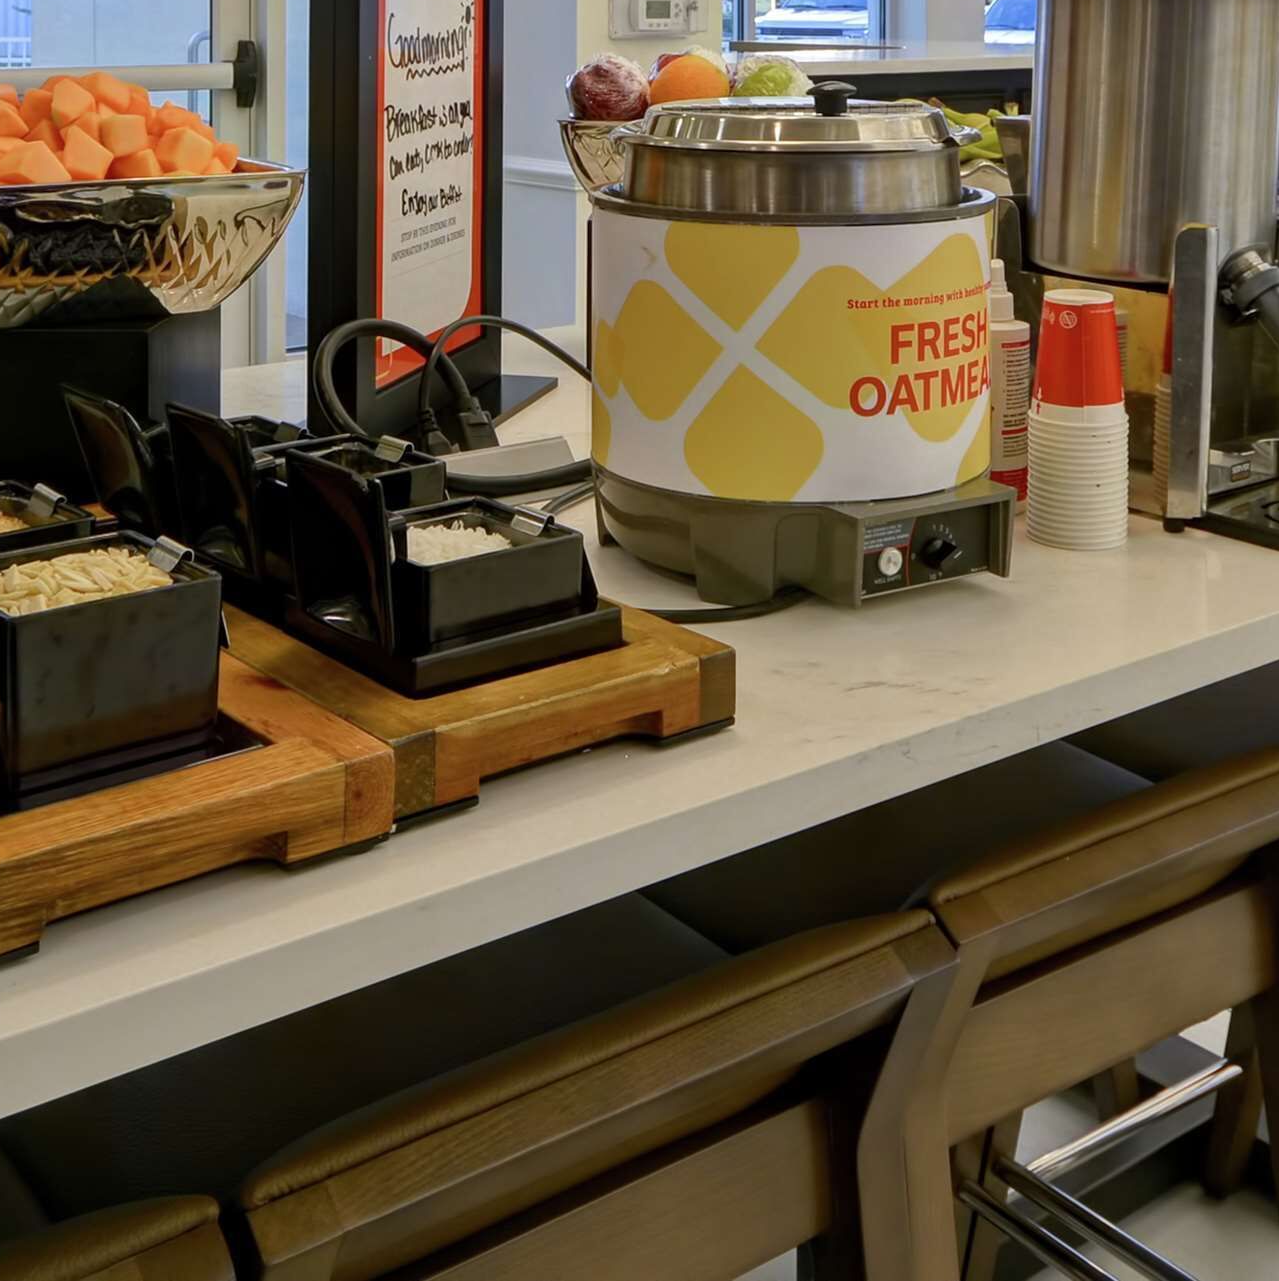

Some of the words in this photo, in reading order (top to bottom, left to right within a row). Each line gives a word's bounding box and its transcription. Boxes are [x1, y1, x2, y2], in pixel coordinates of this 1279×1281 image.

[847, 297, 879, 309] Start
[883, 296, 901, 307] the
[904, 293, 944, 306] morning
[946, 289, 963, 301] with
[891, 308, 988, 365] FRESH
